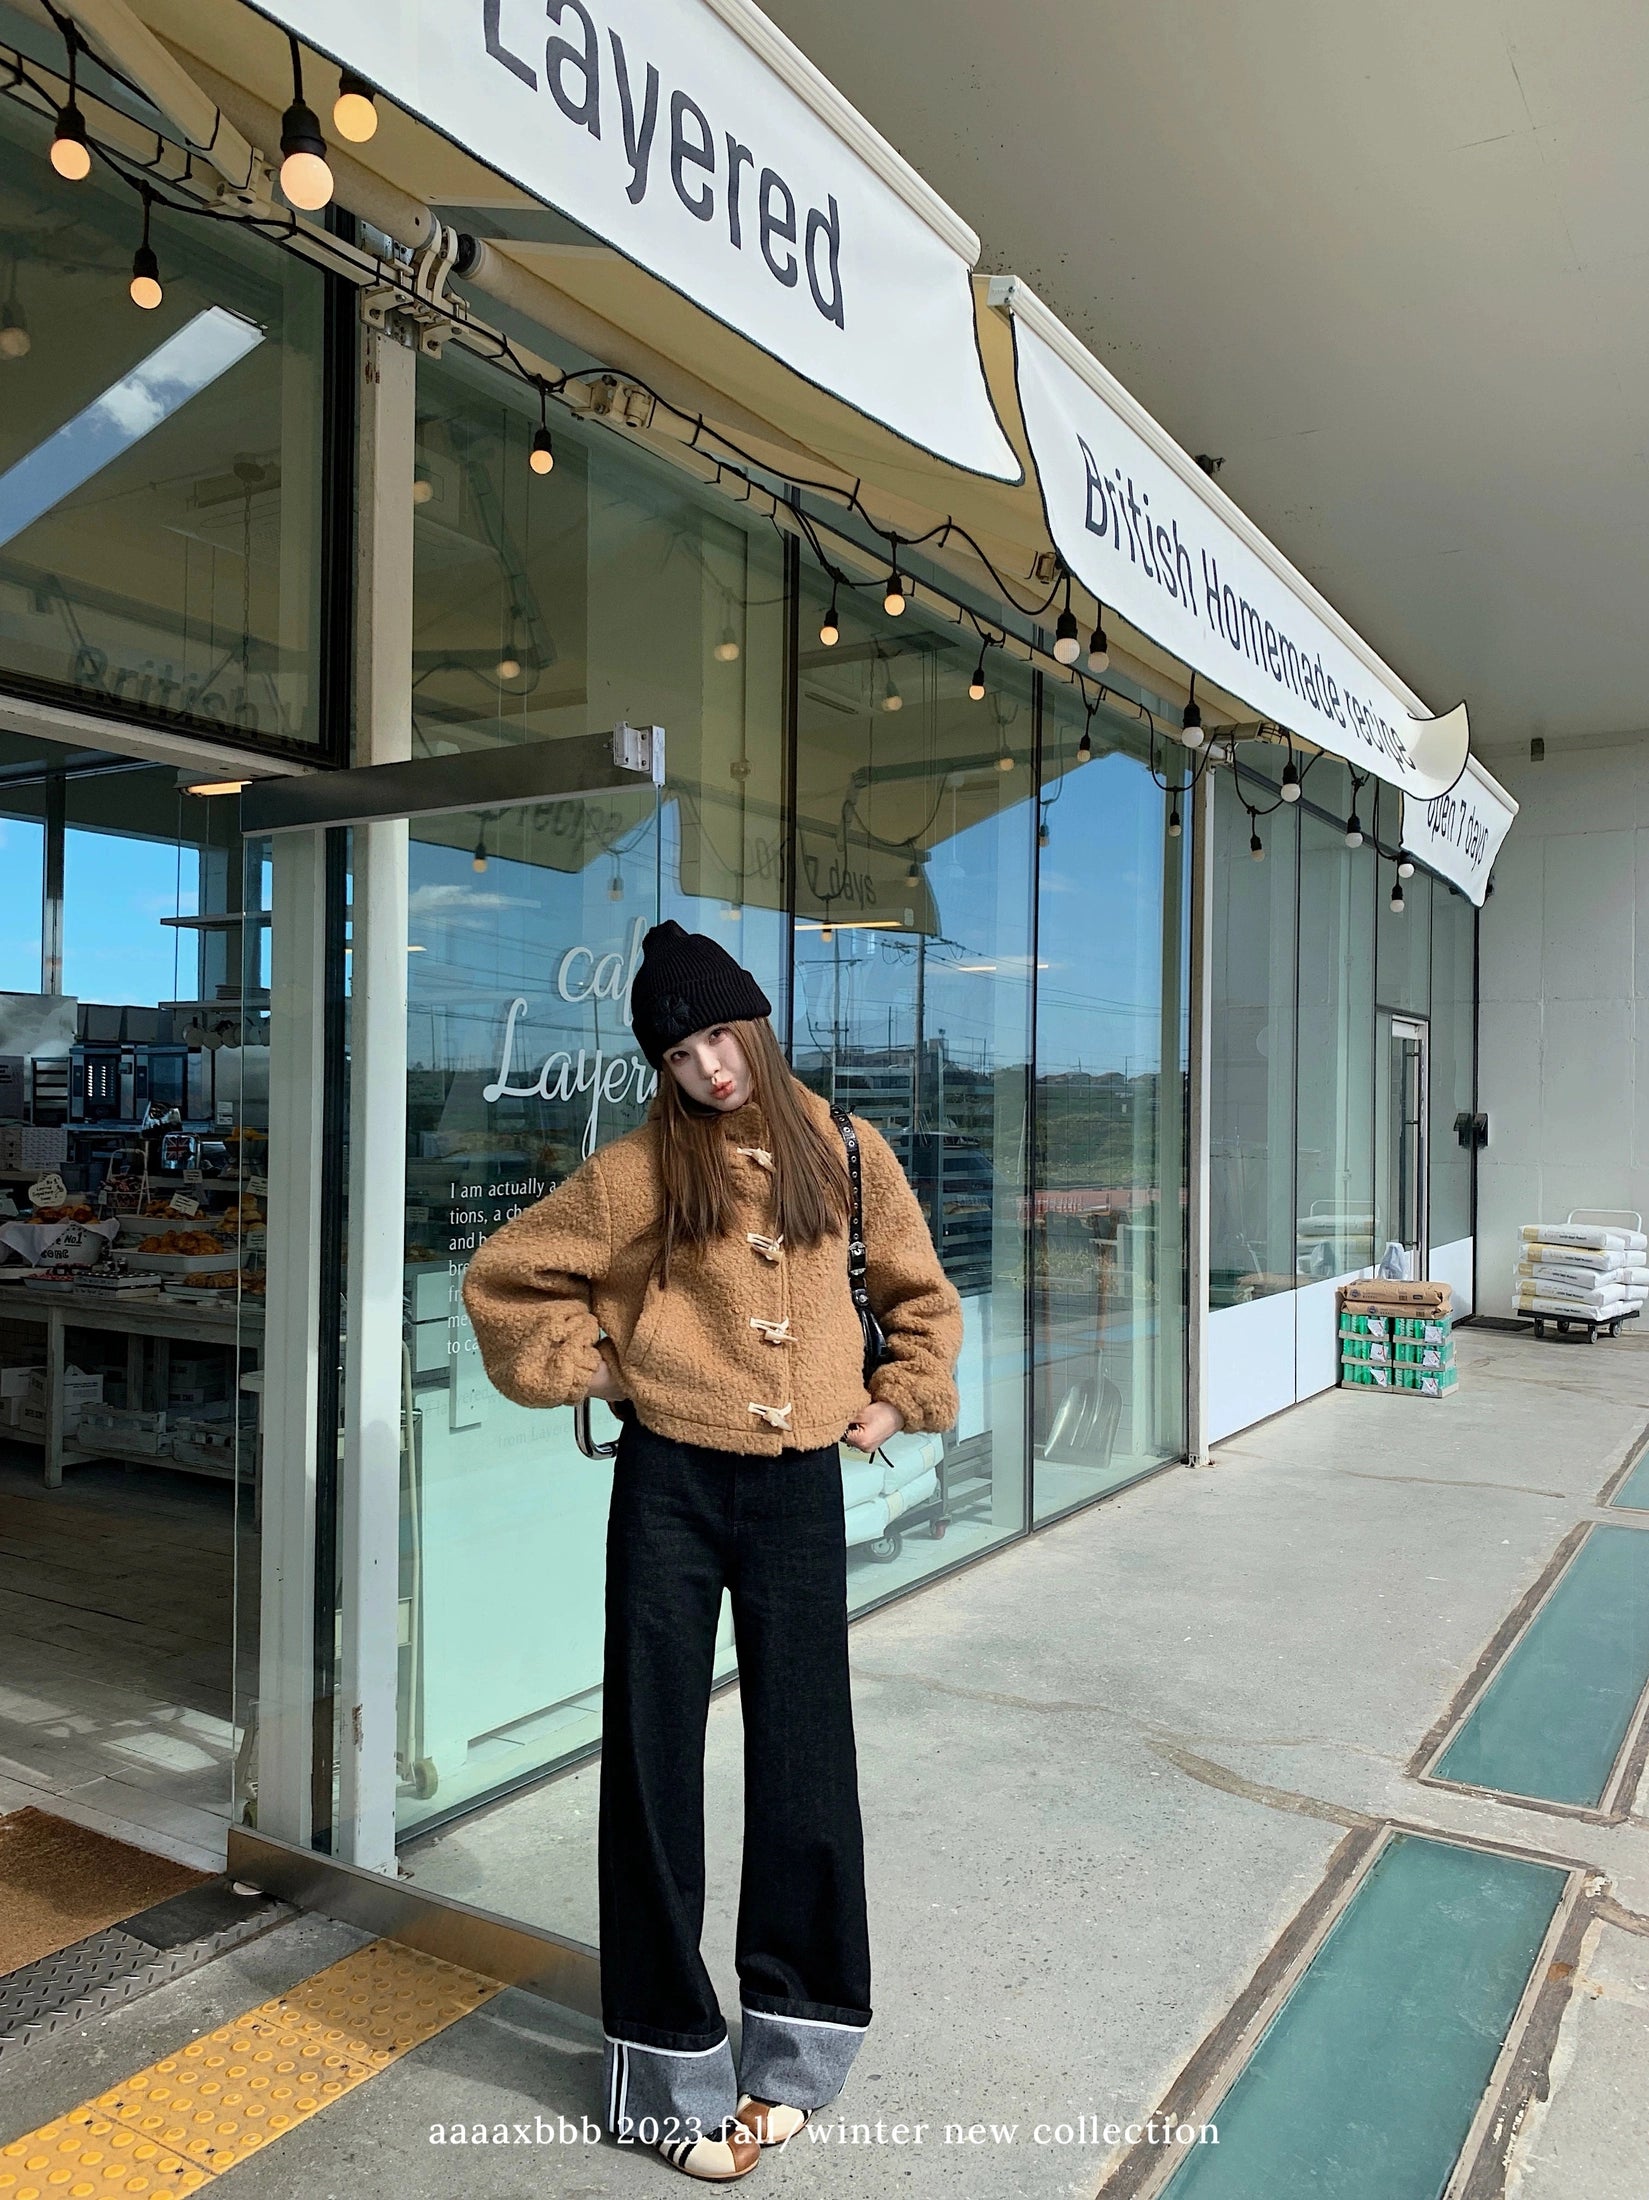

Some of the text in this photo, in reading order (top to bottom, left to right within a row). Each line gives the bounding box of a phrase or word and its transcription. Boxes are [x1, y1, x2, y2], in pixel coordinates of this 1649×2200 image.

[1076, 432, 1417, 774] British Homemade recipe
[1427, 794, 1489, 873] open 7 days
[482, 997, 658, 1161] Layer
[450, 1182, 456, 1199] I
[460, 1184, 483, 1198] am
[488, 1177, 545, 1198] actually
[449, 1207, 488, 1225] tions,
[493, 1208, 502, 1222] a
[449, 1231, 475, 1251] and
[447, 1339, 461, 1355] to
